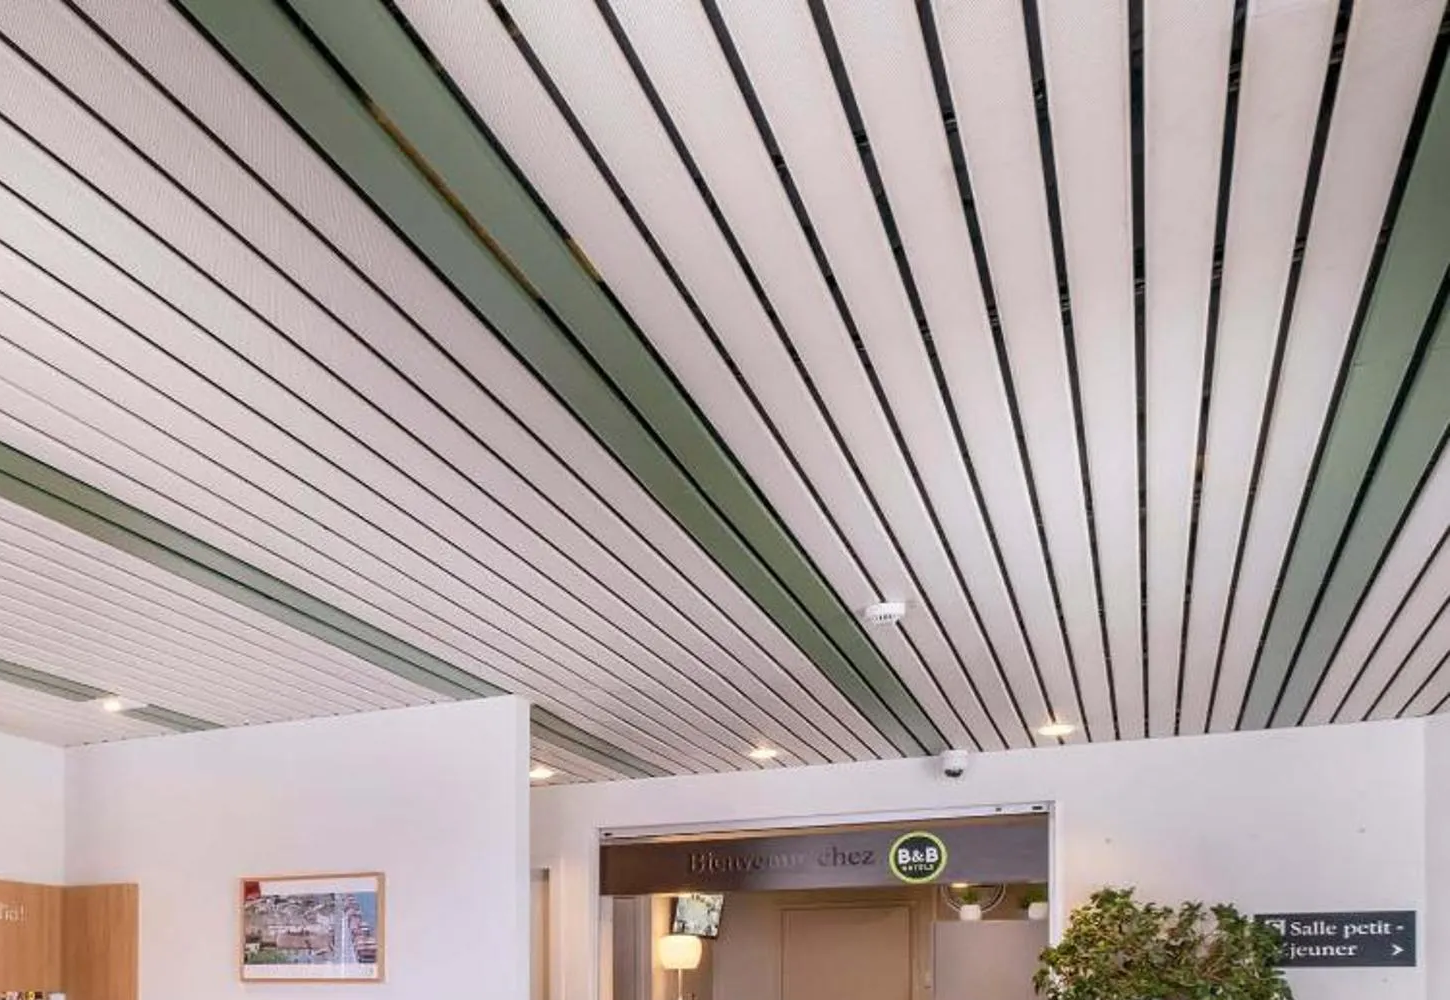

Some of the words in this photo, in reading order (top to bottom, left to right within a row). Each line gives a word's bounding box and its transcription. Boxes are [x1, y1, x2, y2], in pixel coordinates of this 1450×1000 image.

[817, 846, 875, 867] chez
[898, 846, 939, 865] B&B
[1289, 920, 1338, 937] Salle
[1343, 920, 1392, 940] petit
[1283, 942, 1359, 960] jeuner
